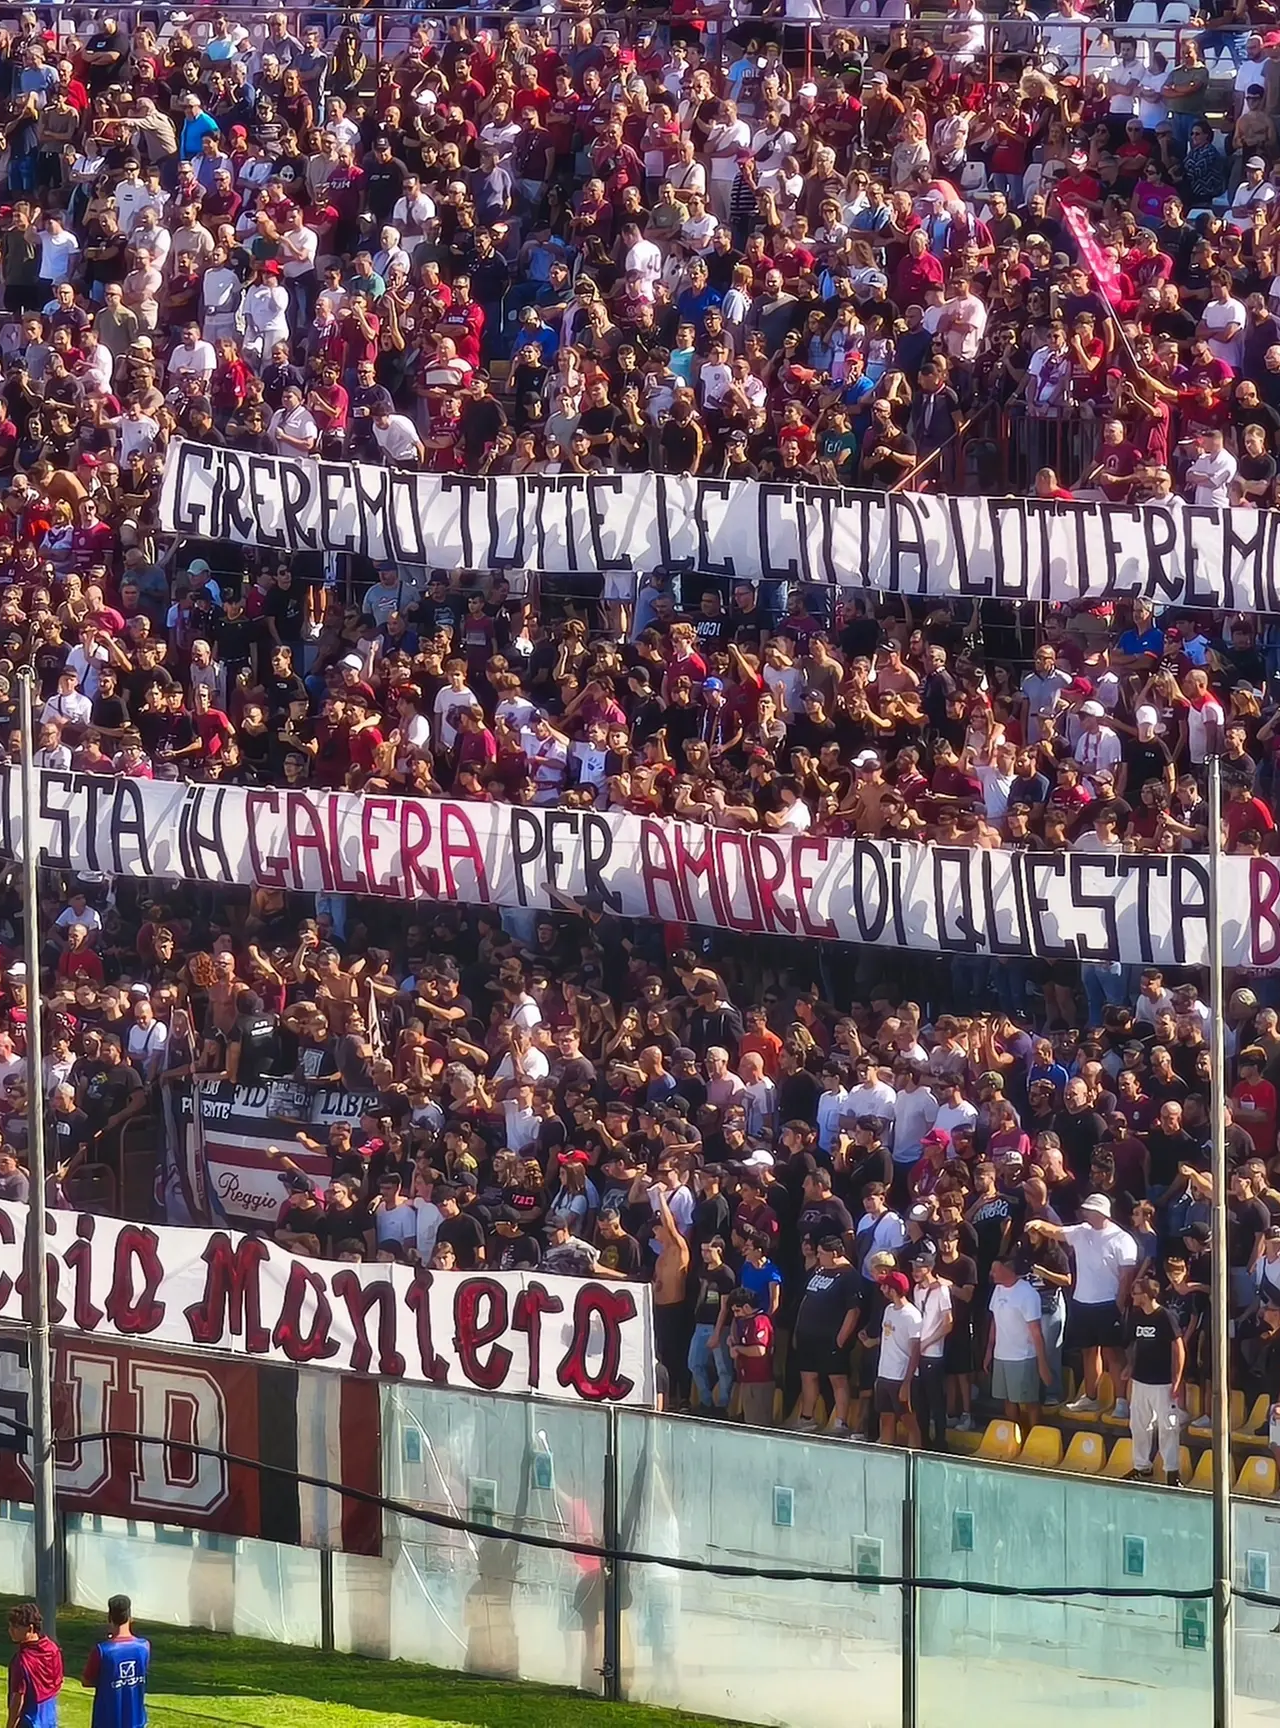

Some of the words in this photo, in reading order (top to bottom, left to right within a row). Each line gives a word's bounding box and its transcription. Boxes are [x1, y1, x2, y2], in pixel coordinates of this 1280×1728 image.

[442, 474, 632, 571] TUTTE
[656, 475, 737, 576] LE
[38, 767, 154, 876] STA
[245, 790, 492, 903] GALERA
[511, 806, 624, 916] PER
[640, 818, 840, 940] AMORE
[931, 845, 1213, 964] QUESTA
[218, 1171, 277, 1212] Reggio
